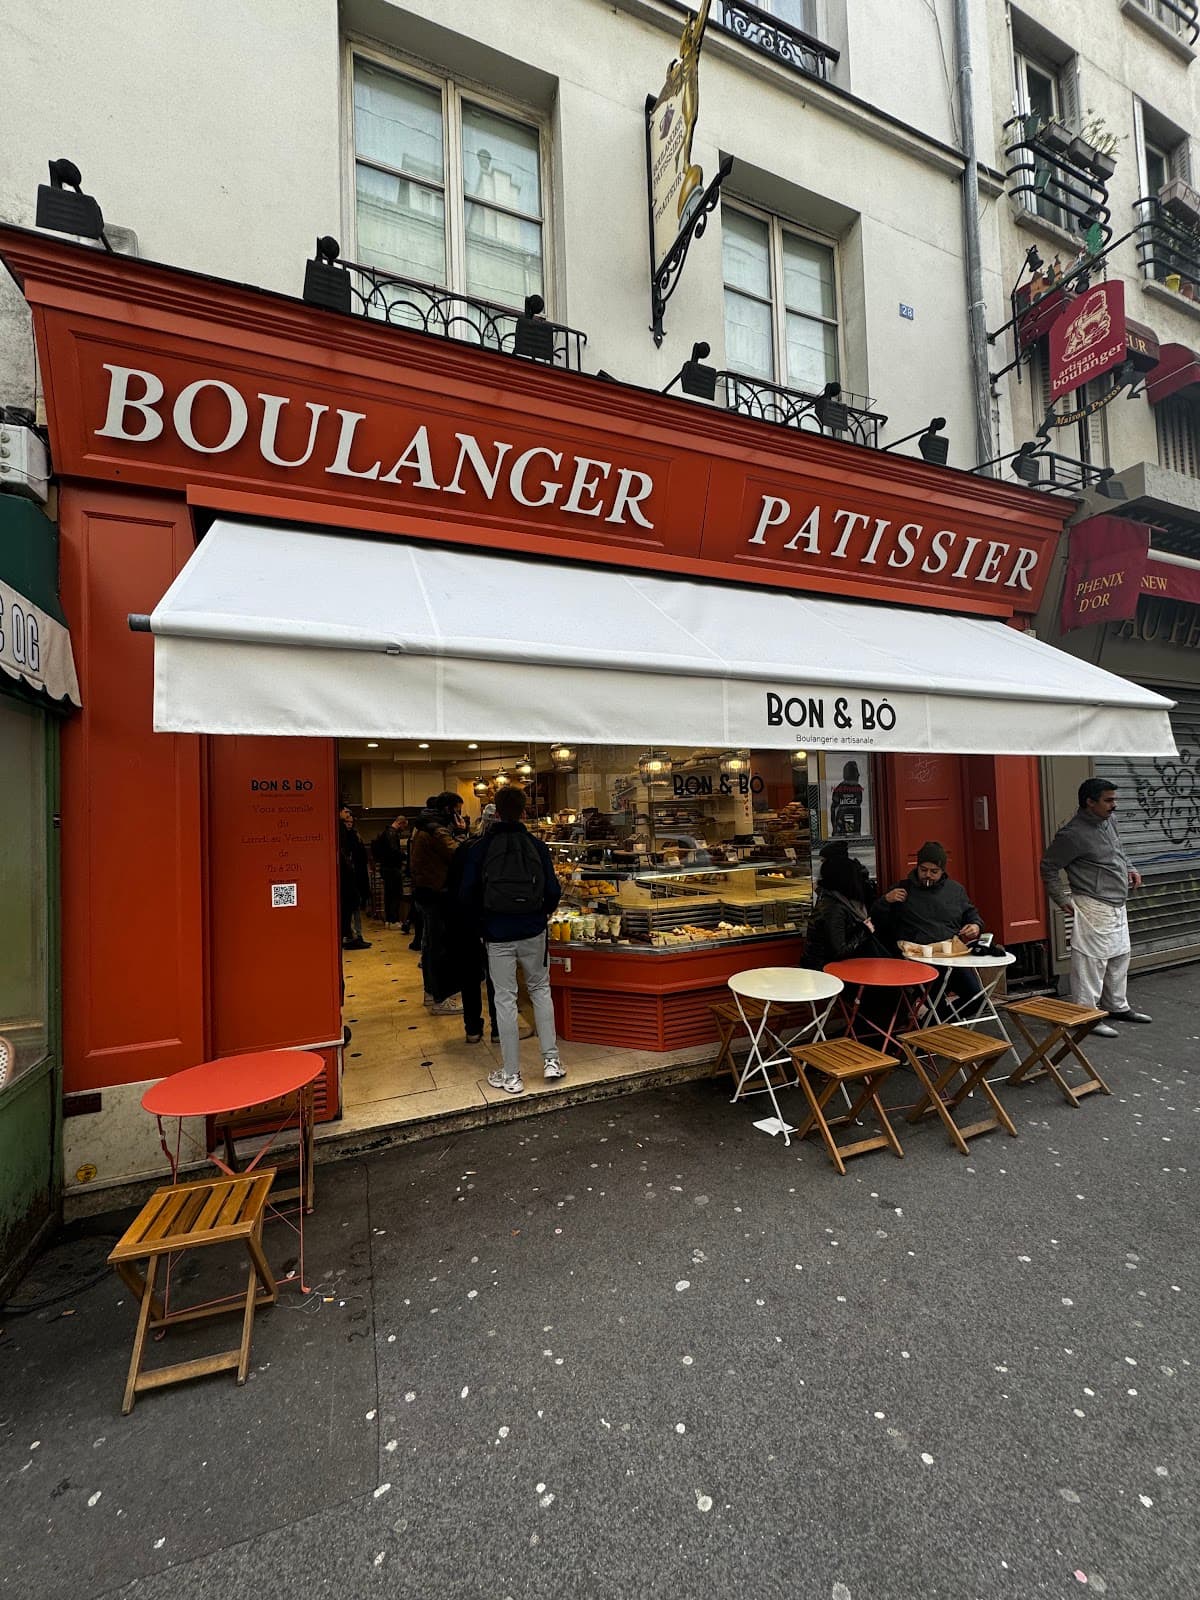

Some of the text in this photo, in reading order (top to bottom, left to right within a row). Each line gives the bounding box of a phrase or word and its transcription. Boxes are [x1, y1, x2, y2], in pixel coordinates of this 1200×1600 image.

[655, 171, 683, 224] TRAITEUR
[1053, 342, 1124, 391] boulanger
[1058, 351, 1096, 379] artisan
[1056, 410, 1087, 426] Maison
[94, 363, 656, 530] BOULANGER
[748, 494, 1039, 591] PATISSIER
[1076, 571, 1125, 595] PHENIX
[1141, 576, 1168, 590] NEW
[1079, 593, 1110, 613] D'OR
[766, 692, 897, 731] BON & BÔ
[796, 734, 874, 744] Boulangerie artisanale
[251, 779, 278, 791] BON
[282, 779, 290, 791] &
[673, 771, 765, 795] BON & BÔ
